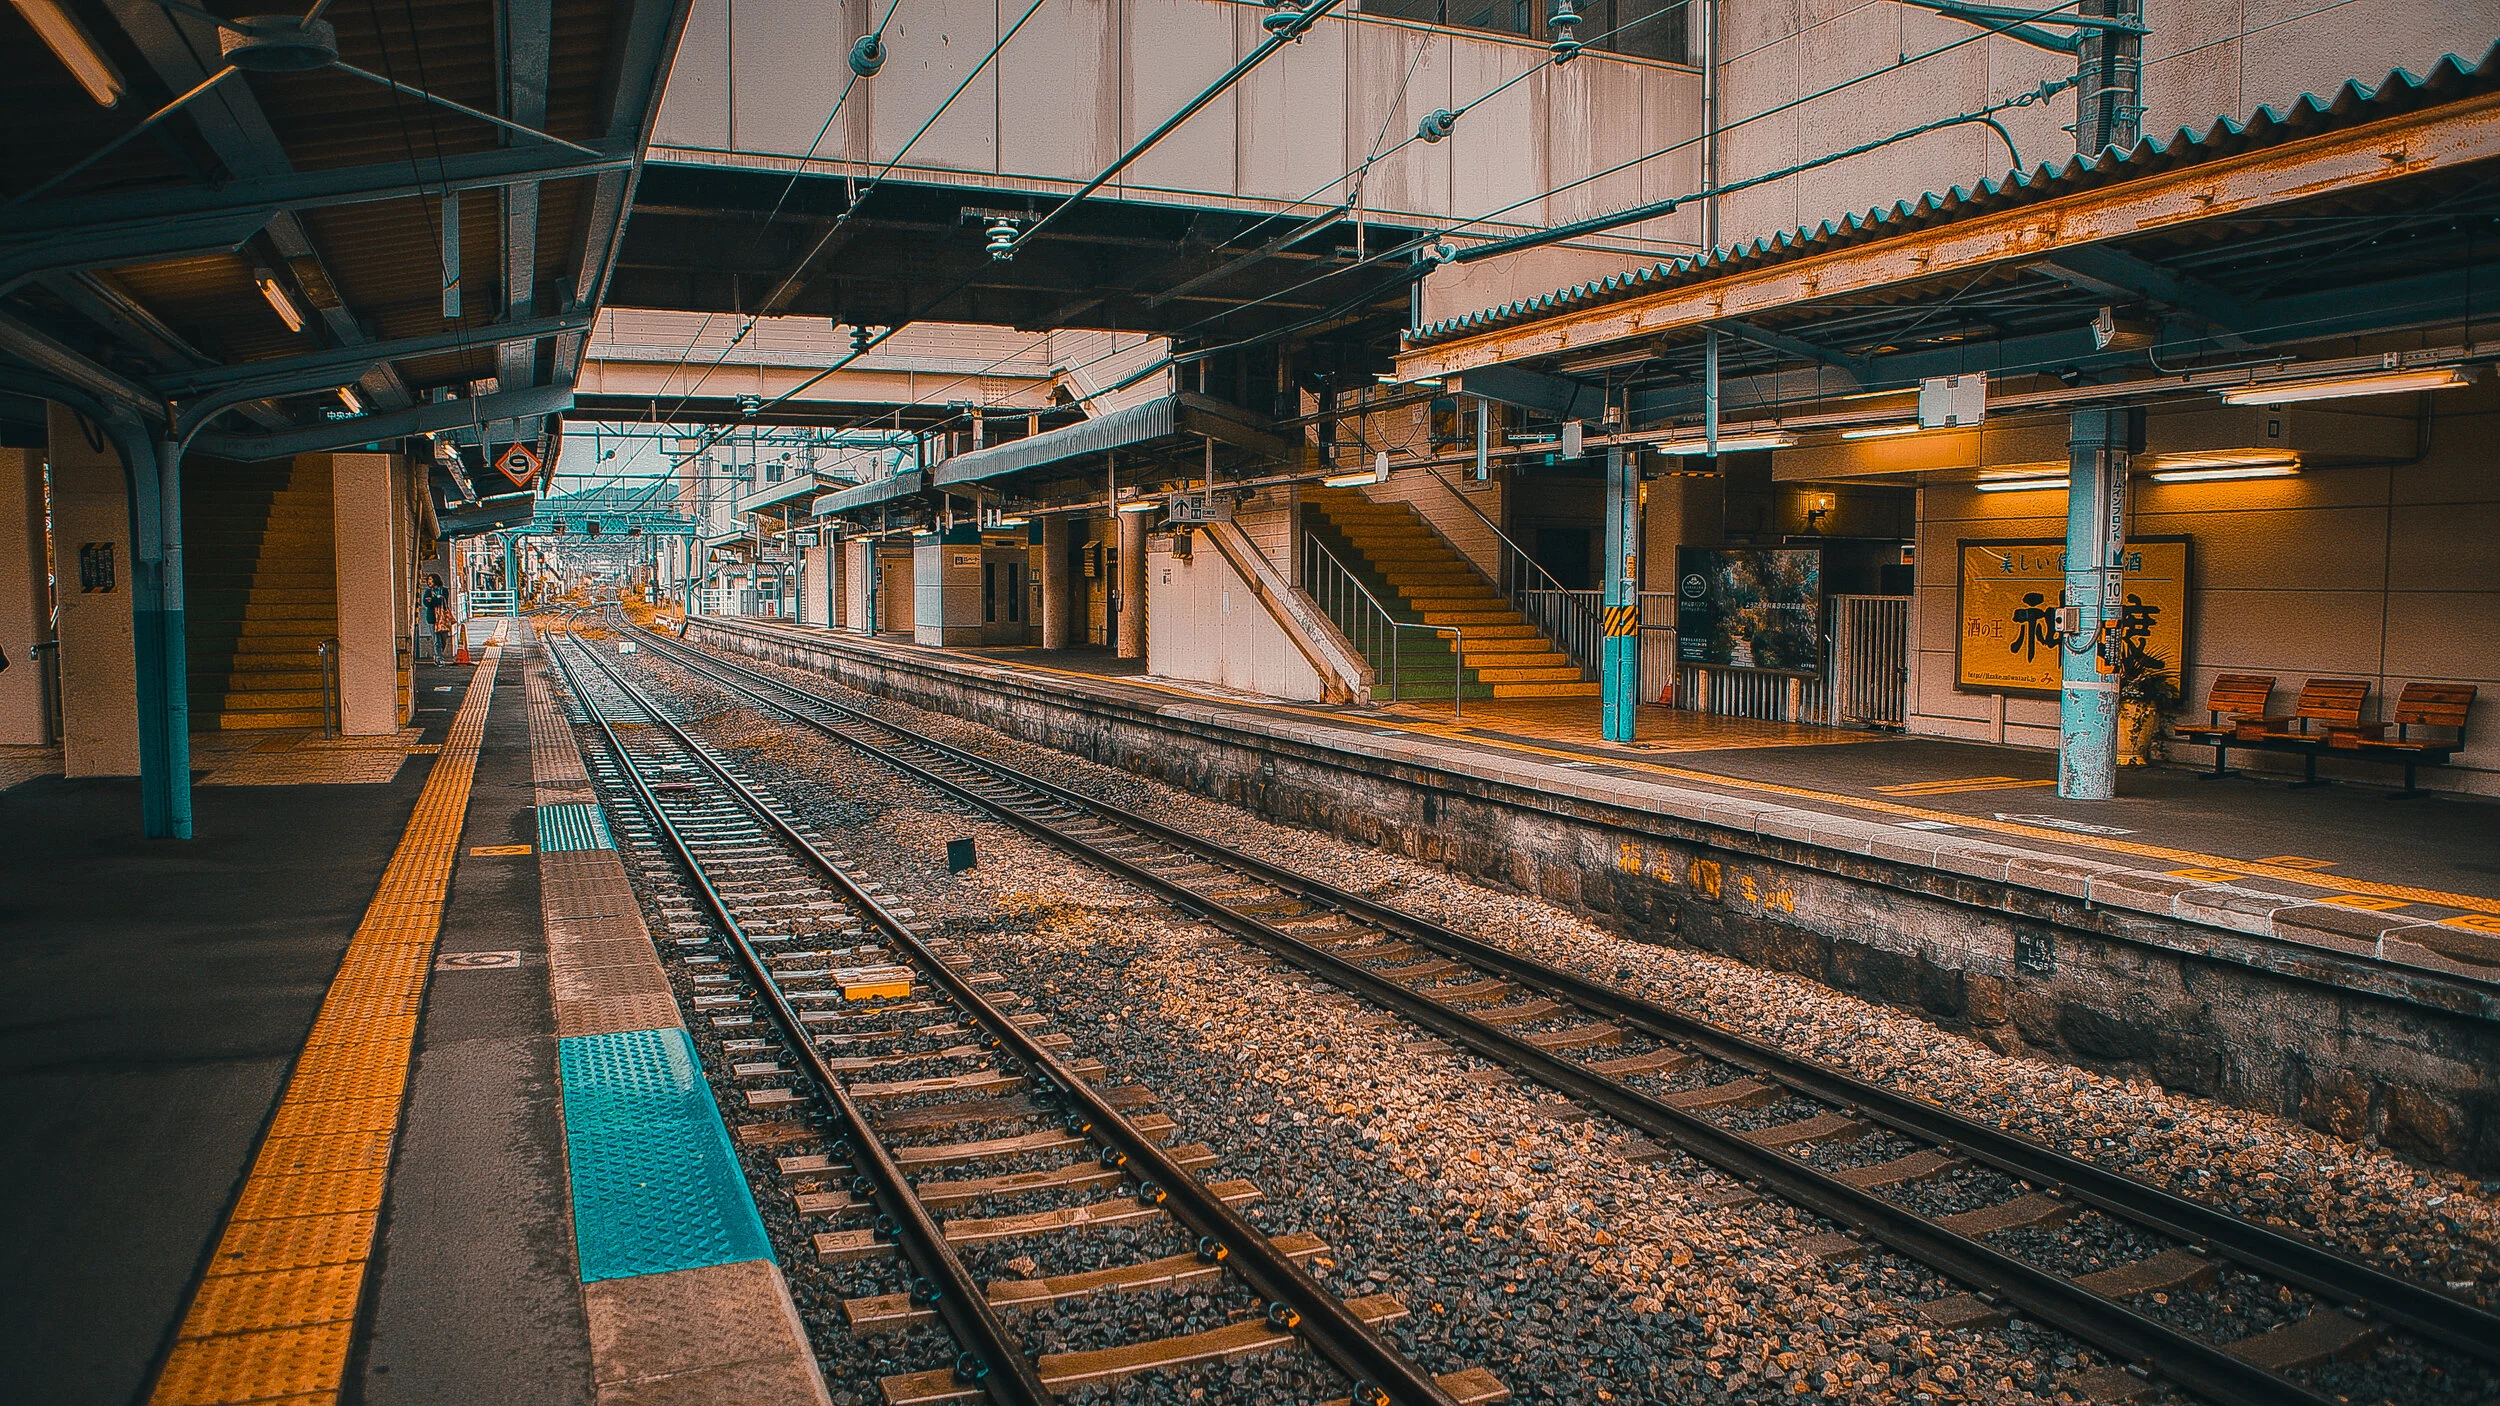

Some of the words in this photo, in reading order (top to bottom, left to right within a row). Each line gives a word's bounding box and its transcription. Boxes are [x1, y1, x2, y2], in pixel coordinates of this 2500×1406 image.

[508, 454, 530, 475] 9
[2106, 582, 2121, 597] 10
[1967, 616, 2003, 638] 酒の王
